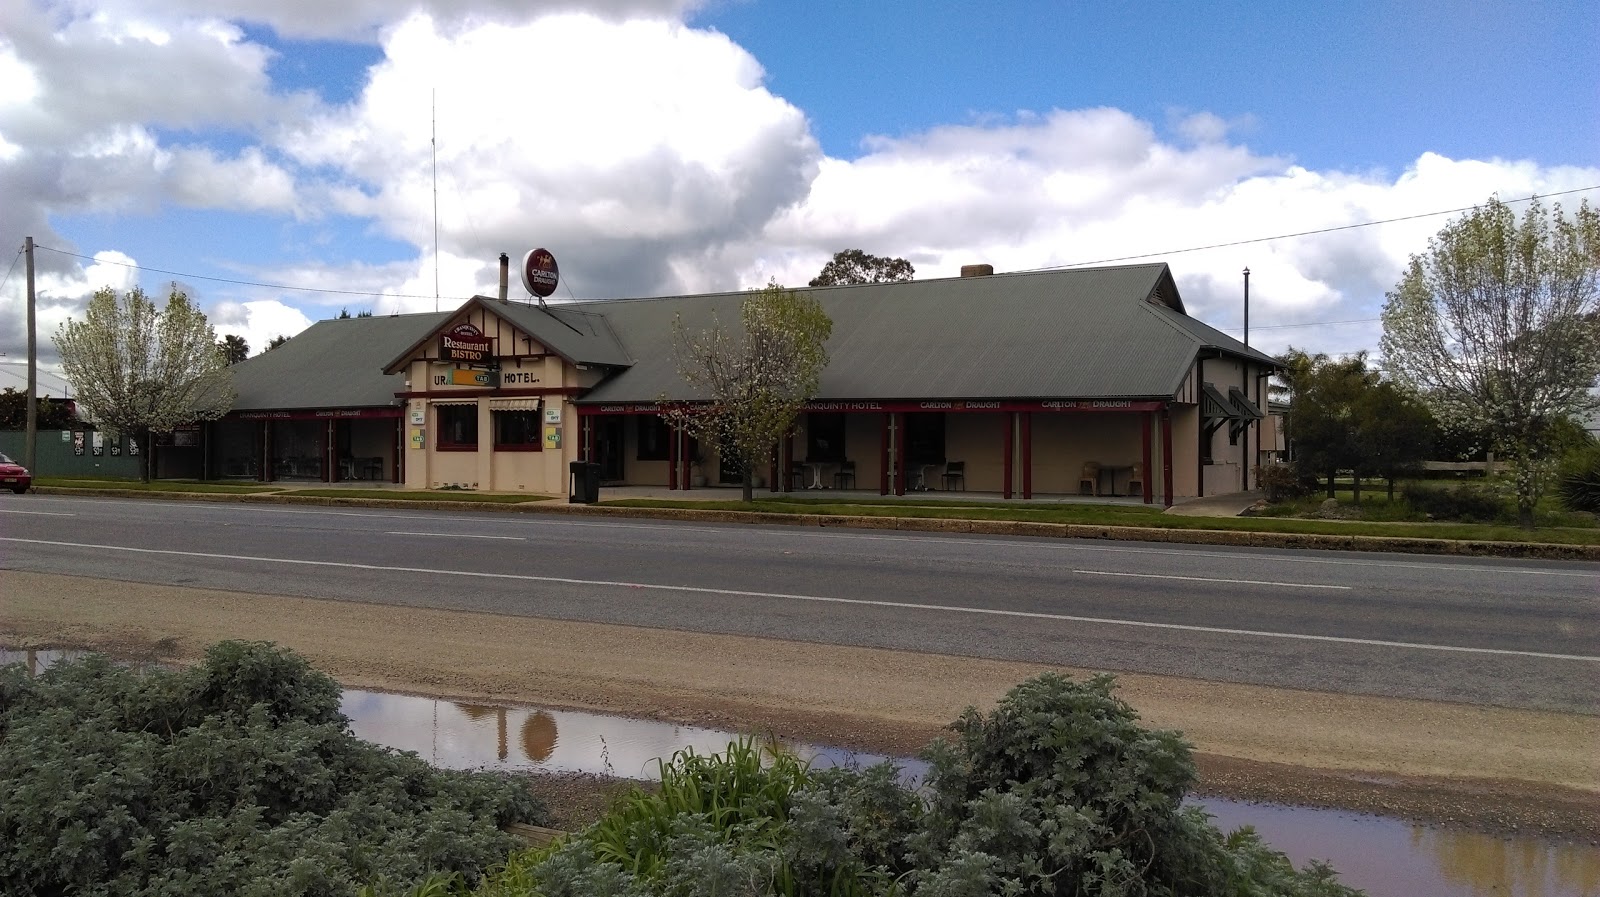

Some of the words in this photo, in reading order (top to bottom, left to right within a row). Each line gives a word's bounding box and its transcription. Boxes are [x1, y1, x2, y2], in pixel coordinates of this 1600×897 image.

[531, 269, 557, 279] CARLTON
[443, 336, 489, 352] Restaurant
[451, 349, 482, 360] BISTRO
[504, 373, 540, 384] HOTEL.
[634, 404, 661, 412] DRAUGHT
[851, 402, 882, 410] HOTEL
[920, 401, 951, 409] CARLTON
[966, 401, 1000, 409] DRAUGHT
[1041, 400, 1077, 408] CARLTON
[1093, 400, 1132, 408] DRAUGHT
